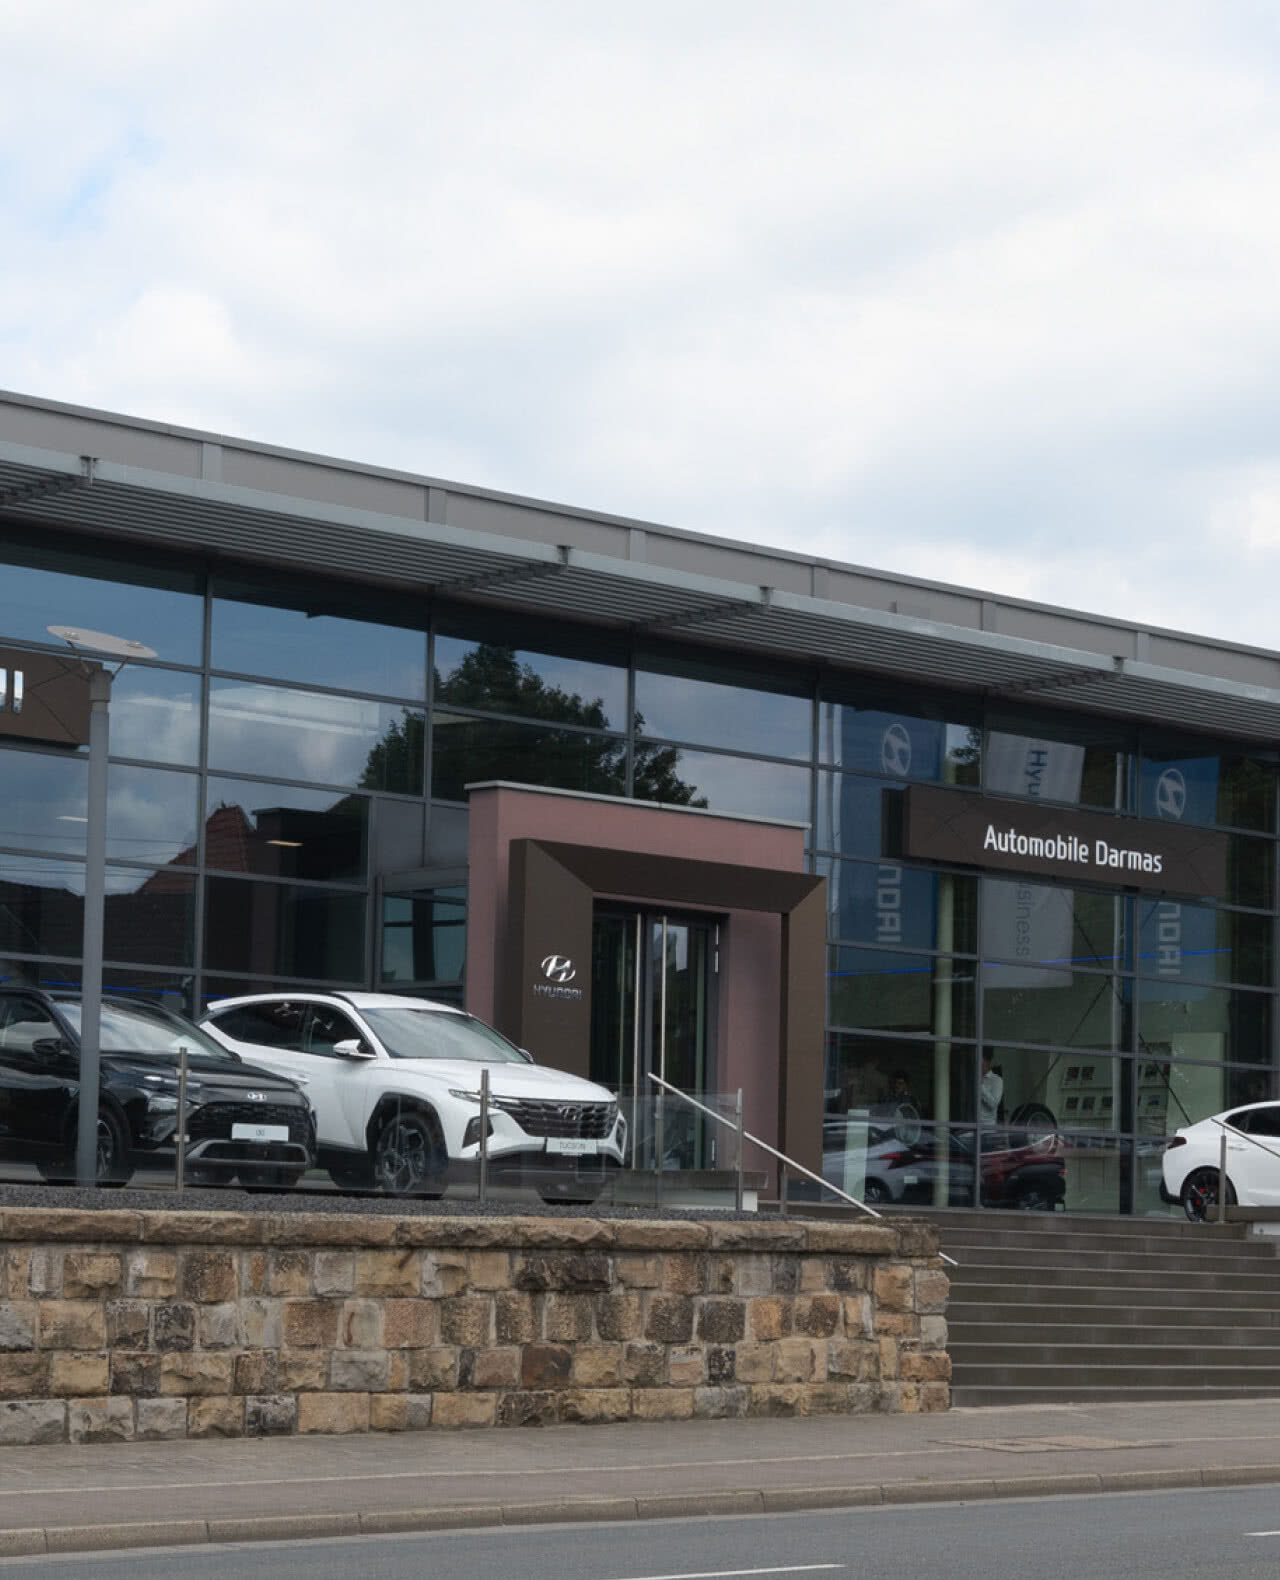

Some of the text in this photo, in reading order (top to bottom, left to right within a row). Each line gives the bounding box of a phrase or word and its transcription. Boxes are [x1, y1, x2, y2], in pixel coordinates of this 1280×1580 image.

[983, 824, 1163, 873] Automobile Darmas
[877, 864, 902, 942] NDAI
[1158, 901, 1181, 975] NDAI
